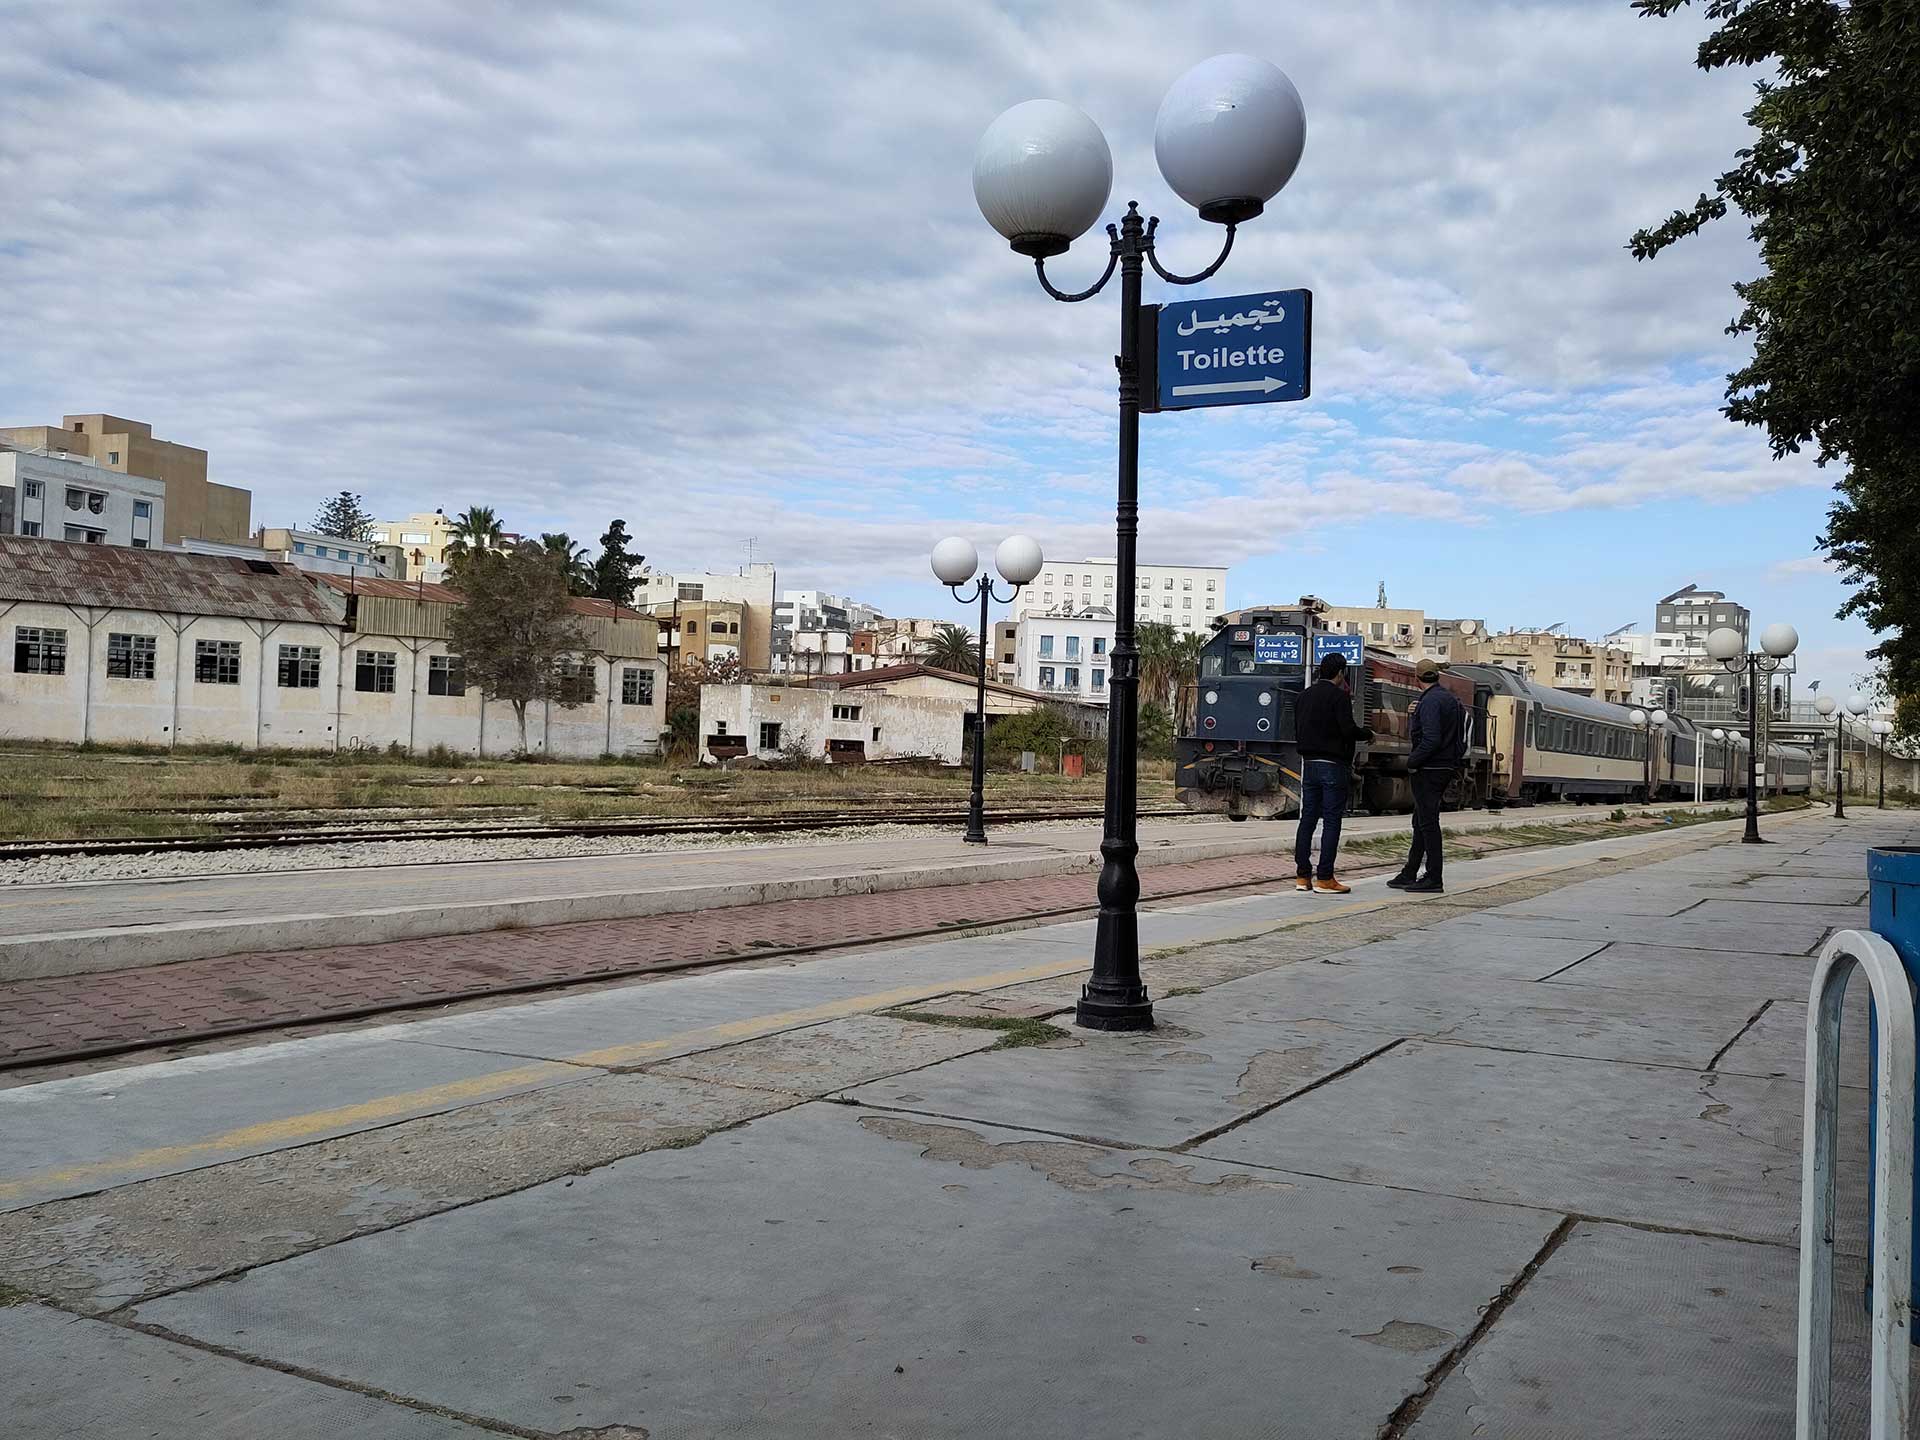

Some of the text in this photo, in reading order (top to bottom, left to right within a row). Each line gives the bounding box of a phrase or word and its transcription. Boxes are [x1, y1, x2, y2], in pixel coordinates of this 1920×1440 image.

[1177, 300, 1286, 336] تجميل
[1177, 345, 1285, 370] Toilette
[1258, 638, 1266, 647] 2
[1317, 637, 1325, 648] 1
[1258, 650, 1279, 659] VOIE
